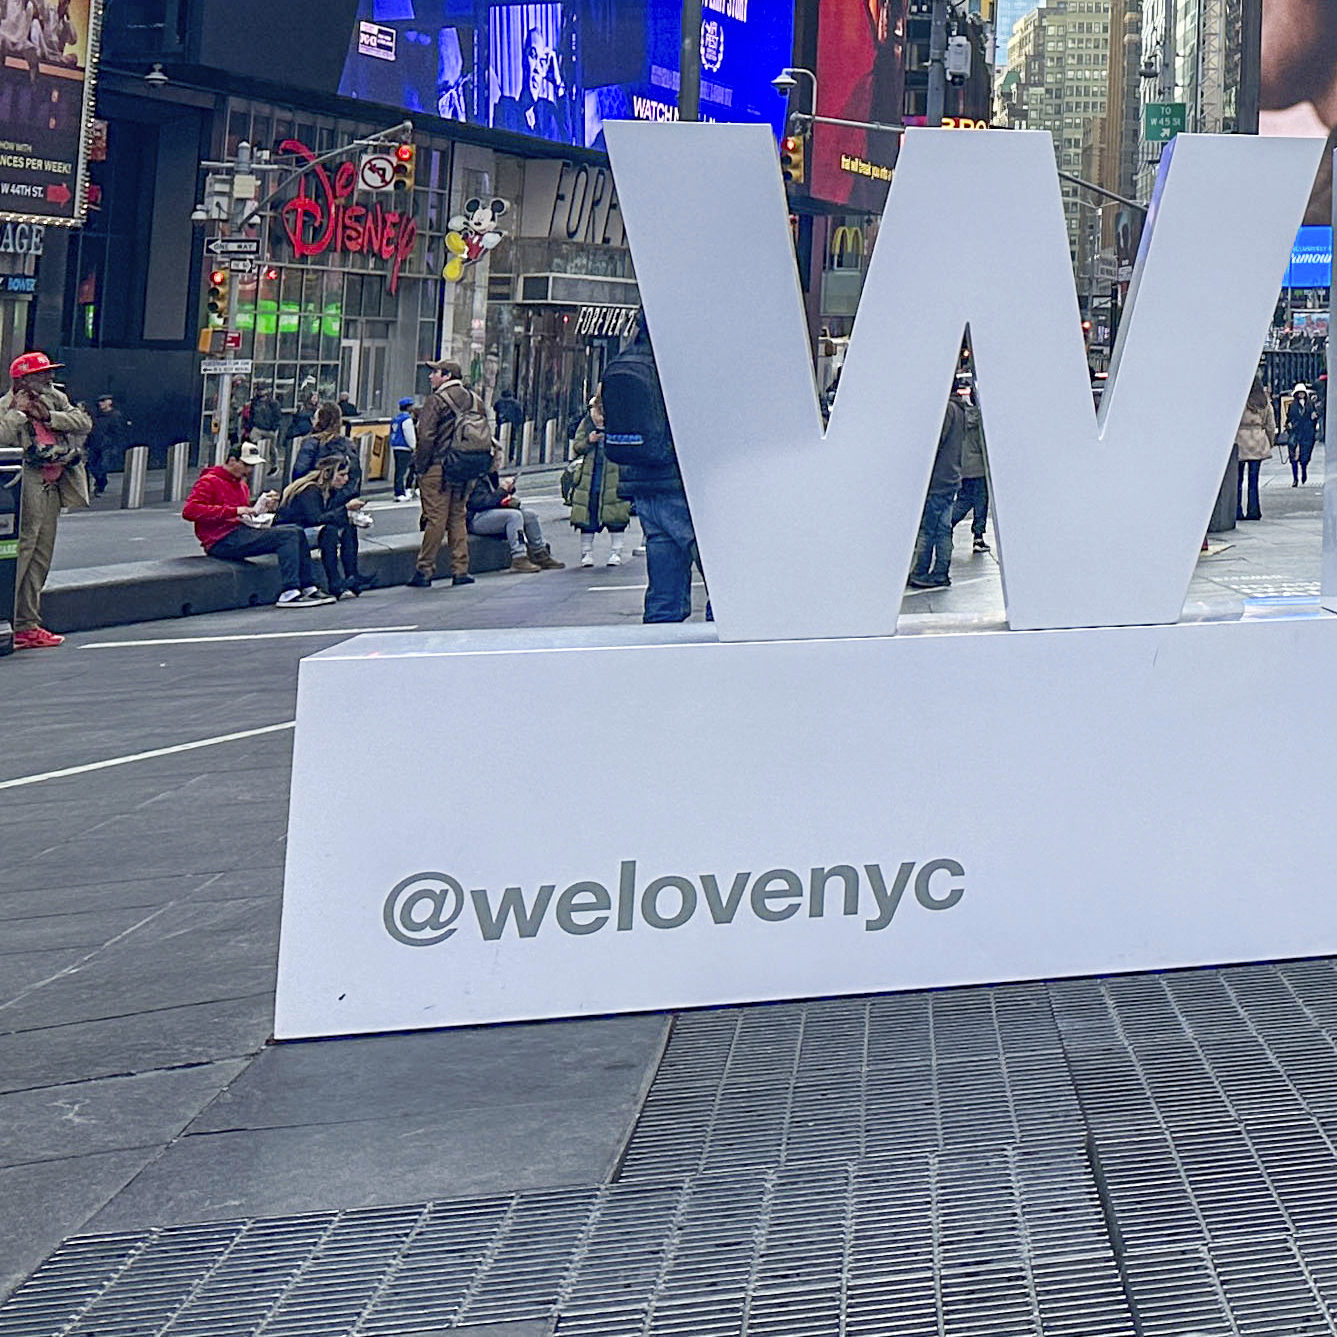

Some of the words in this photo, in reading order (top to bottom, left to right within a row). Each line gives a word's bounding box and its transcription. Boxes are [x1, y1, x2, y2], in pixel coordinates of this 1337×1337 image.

[633, 95, 671, 122] WATCH
[1161, 106, 1172, 115] TO
[1151, 117, 1157, 126] W
[25, 157, 43, 170] PER
[0, 182, 10, 194] W
[548, 161, 628, 246] FORE
[575, 306, 624, 336] FOREVER
[382, 857, 966, 948] @welovenyc
